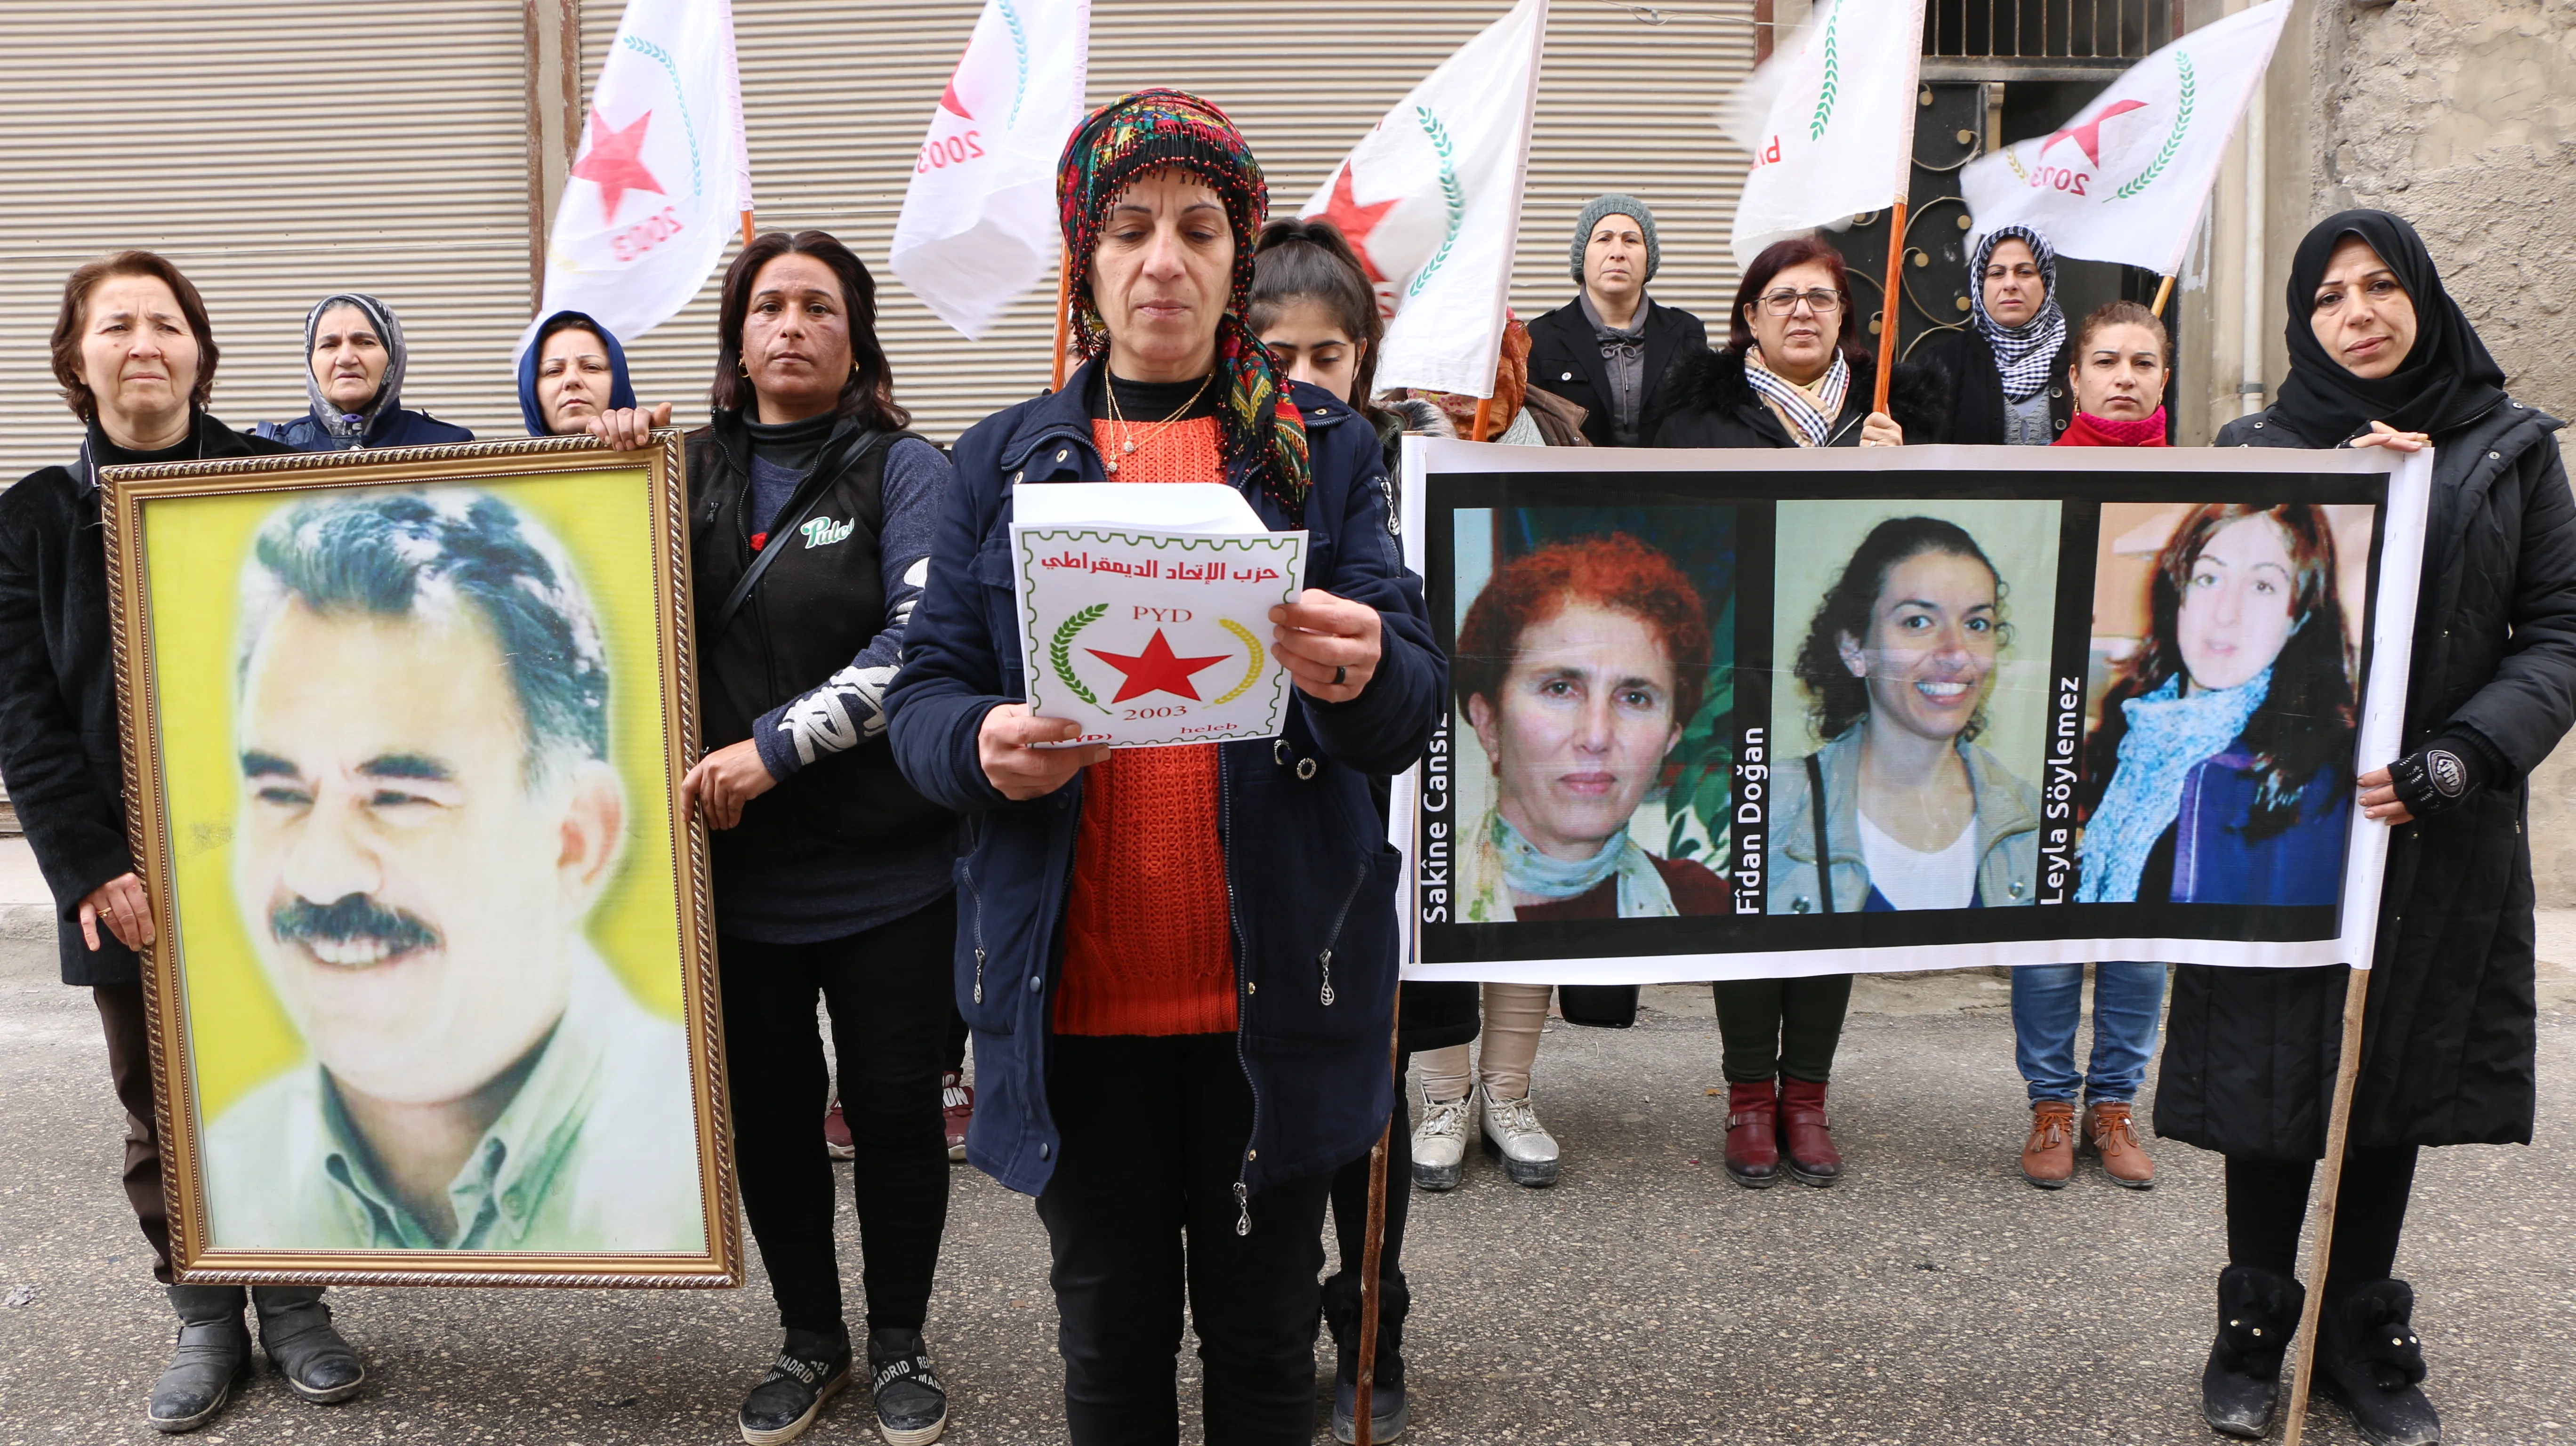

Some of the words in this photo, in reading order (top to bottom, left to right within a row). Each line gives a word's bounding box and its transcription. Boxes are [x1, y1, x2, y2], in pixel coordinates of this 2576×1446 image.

[1041, 551, 1158, 578] الديمقراطي
[1166, 562, 1226, 585] الإتحاد
[1232, 567, 1279, 584] حزب
[1133, 605, 1192, 623] PYD
[1123, 705, 1187, 721] 2003
[1180, 723, 1238, 734] heleb
[2046, 676, 2079, 819] Söylemez
[1736, 728, 1769, 824] Doğan
[1421, 822, 1448, 923] Sakîne
[1734, 834, 1761, 914] Fîdan
[2040, 828, 2070, 905] Leyla
[942, 1086, 969, 1109] ON
[775, 1354, 814, 1383] MADRID
[873, 1360, 910, 1396] MADRID
